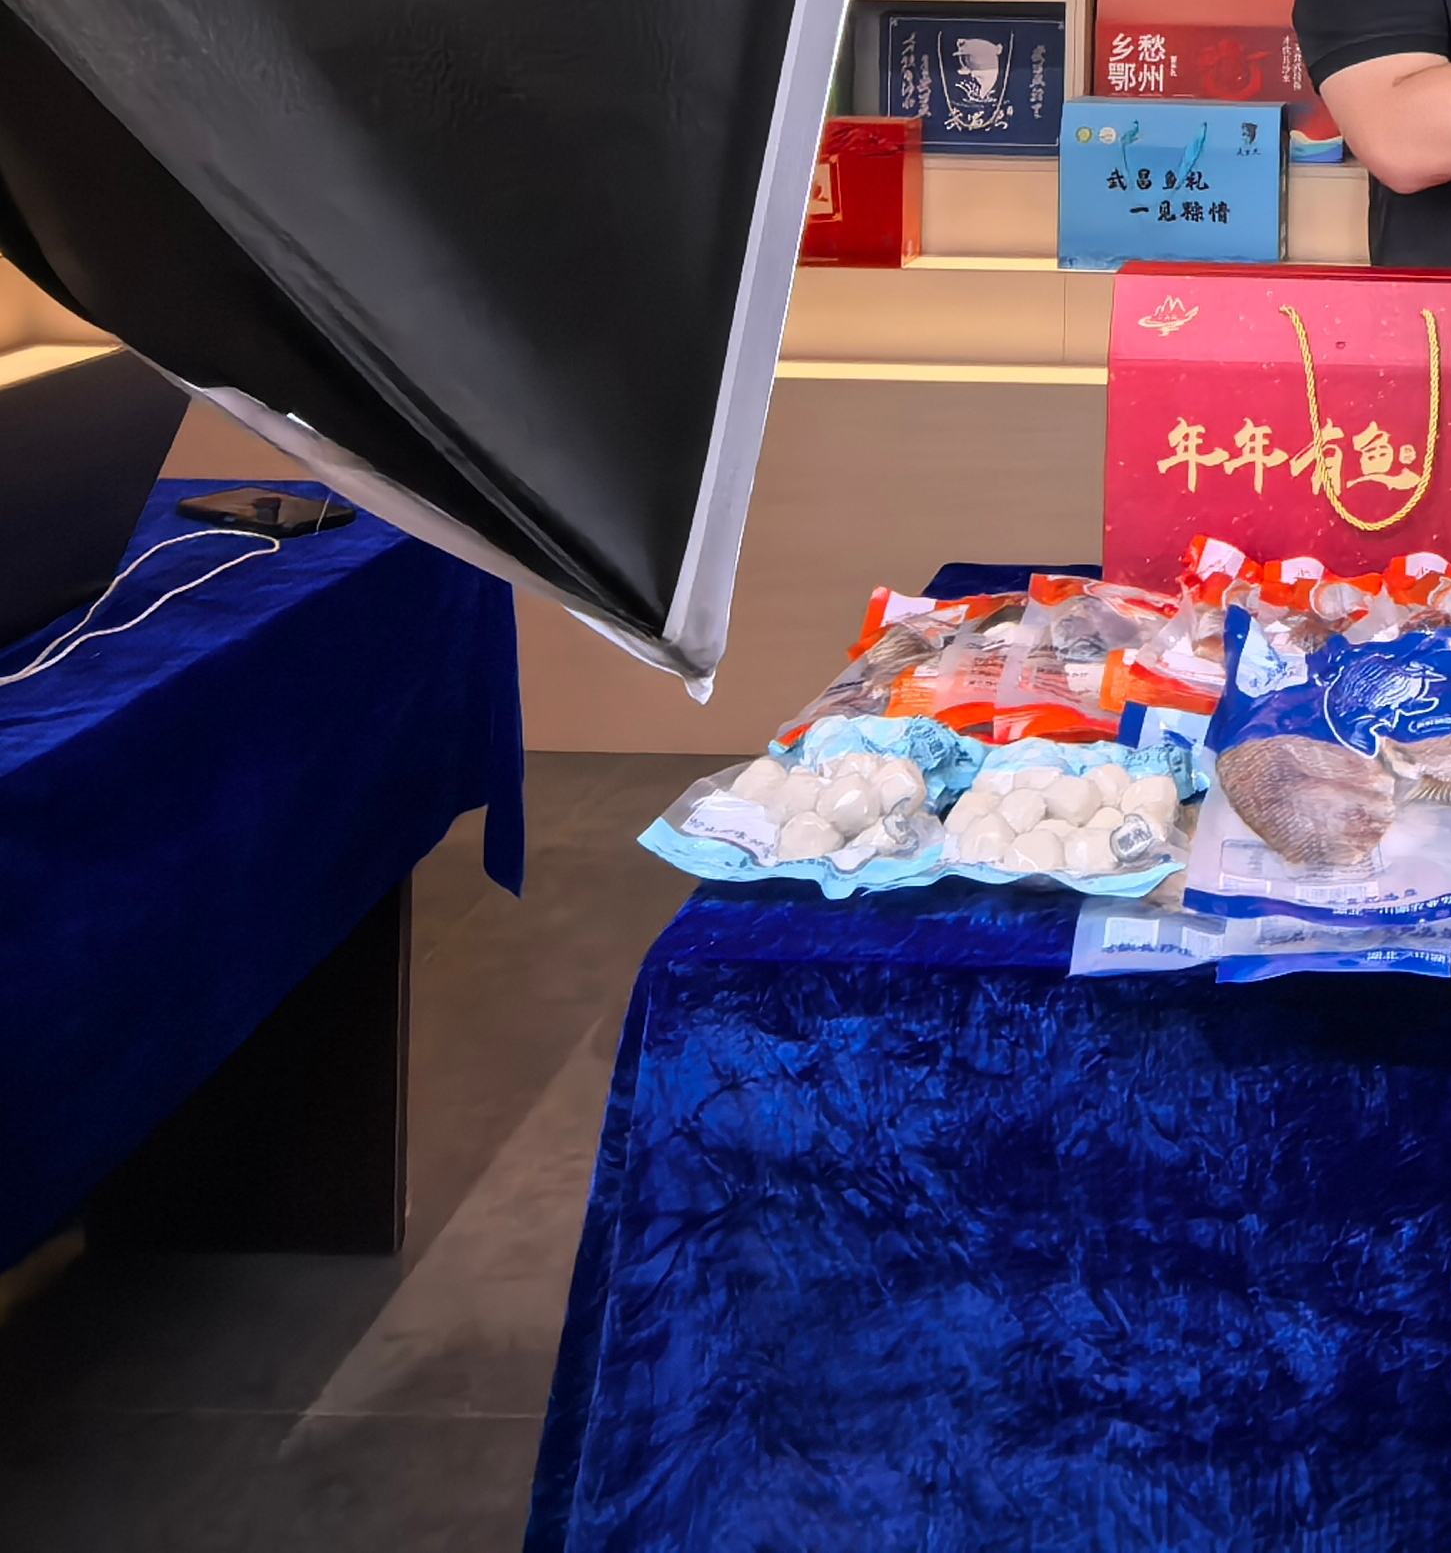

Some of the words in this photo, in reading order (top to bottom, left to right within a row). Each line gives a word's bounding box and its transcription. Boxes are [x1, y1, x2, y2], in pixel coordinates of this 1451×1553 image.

[1109, 33, 1166, 62] 乡愁
[1107, 63, 1164, 92] 鄂州
[1157, 417, 1421, 496] 年年有鱼
